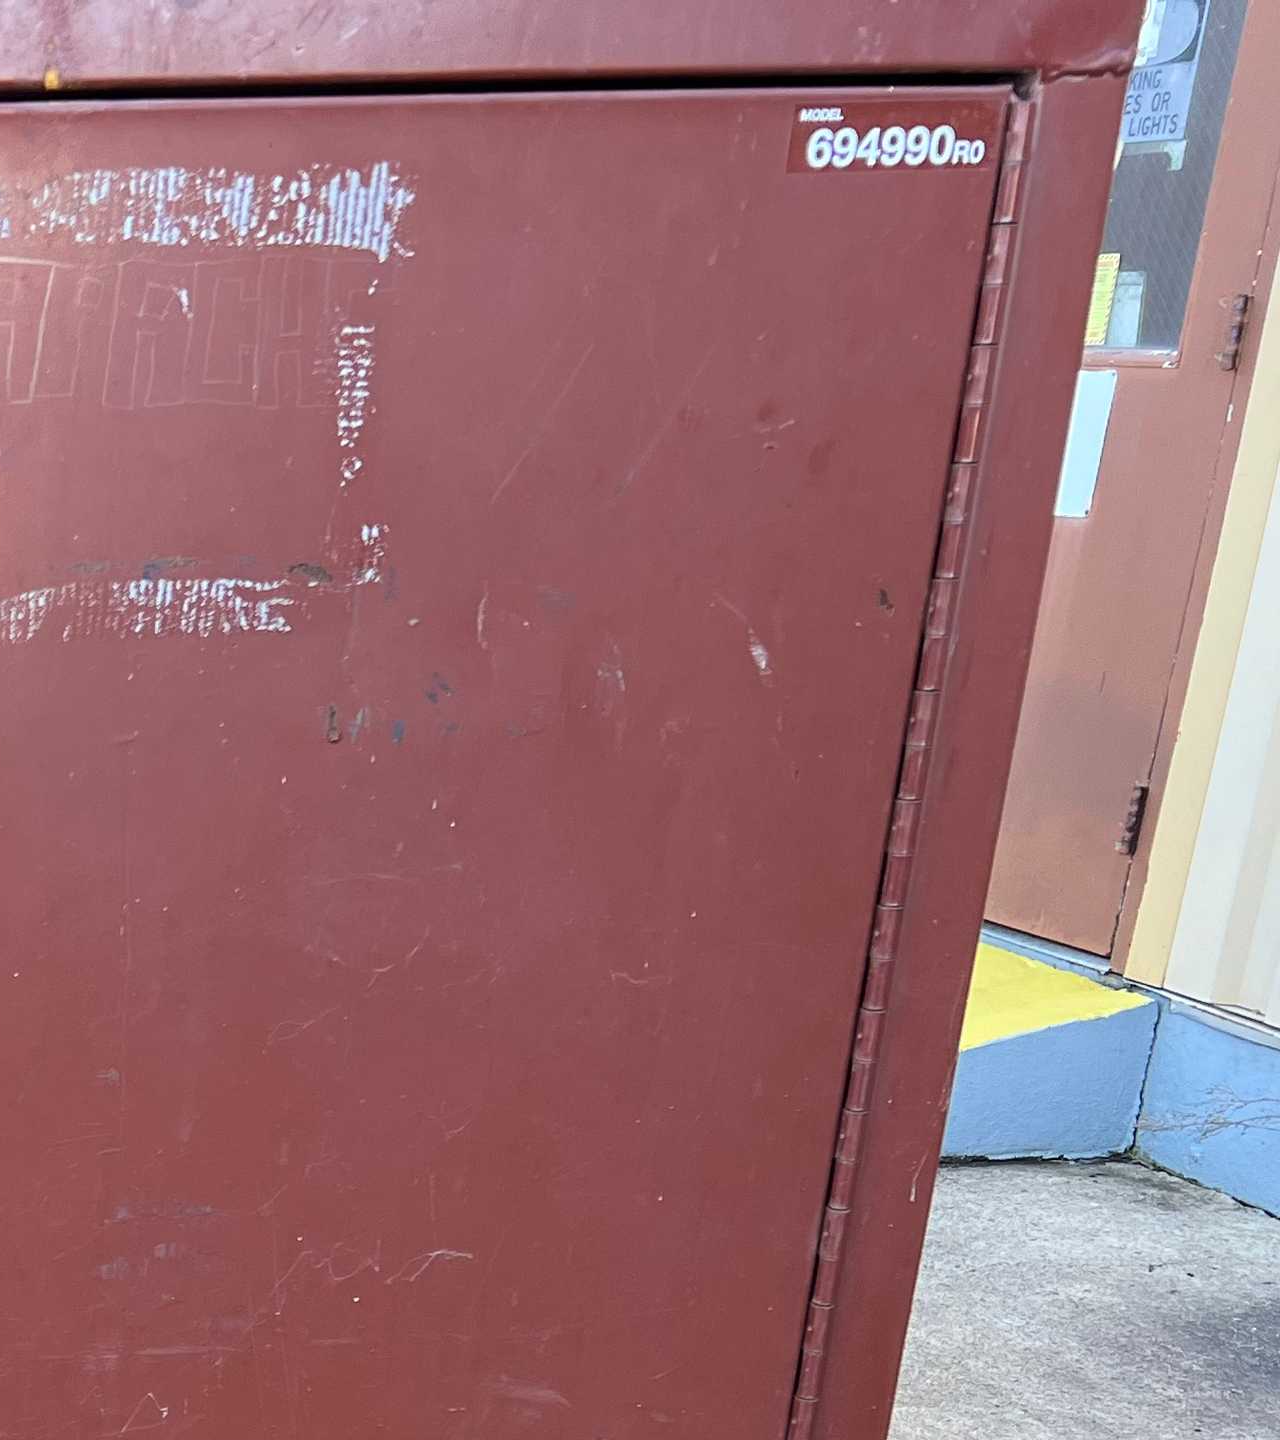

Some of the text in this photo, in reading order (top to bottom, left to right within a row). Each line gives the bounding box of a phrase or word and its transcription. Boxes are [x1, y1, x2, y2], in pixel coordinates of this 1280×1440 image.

[1152, 92, 1171, 111] OR
[800, 108, 844, 122] MODEL
[1129, 115, 1177, 136] LIGHTS
